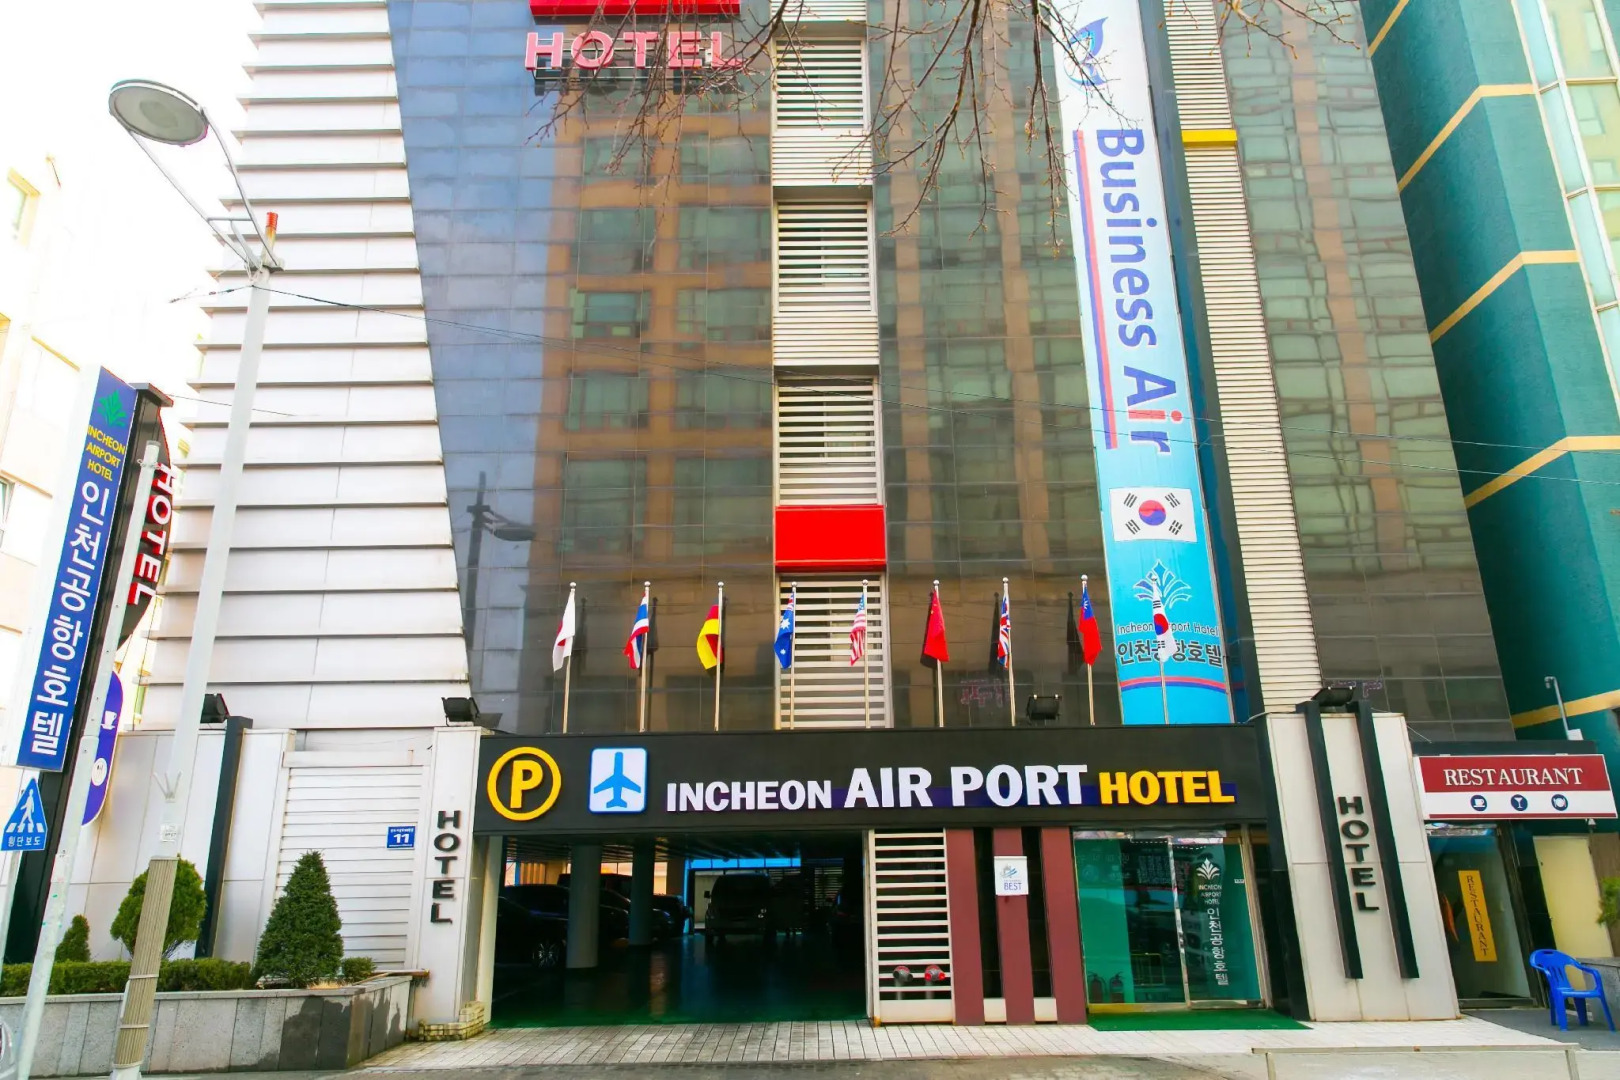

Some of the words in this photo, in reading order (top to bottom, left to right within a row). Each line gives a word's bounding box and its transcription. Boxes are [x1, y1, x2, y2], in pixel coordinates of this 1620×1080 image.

[525, 31, 745, 70] HOTEL
[1095, 129, 1158, 348] Business
[1123, 365, 1183, 455] Air
[86, 442, 121, 469] AIRPORT
[87, 425, 126, 455] INCHEON
[87, 459, 113, 481] HOTEL
[127, 462, 177, 606] HOTEL
[31, 481, 110, 756] 인천공항호텔
[1117, 622, 1154, 634] Incheon
[1194, 623, 1219, 636] Hotel
[1118, 640, 1222, 668] 인천항호텔
[667, 779, 832, 812] INCHEON
[844, 767, 933, 808] AIR
[950, 764, 1088, 807] PORT
[1099, 770, 1235, 804] HOTEL
[1443, 767, 1584, 787] RESTAURANT
[8, 835, 41, 847] 횡단보도
[393, 833, 410, 844] 11
[1338, 795, 1380, 913] HOTEL
[430, 810, 461, 924] HOTEL
[1004, 882, 1022, 891] BEST
[1466, 875, 1488, 956] RESTAURANT
[1207, 908, 1229, 985] 인천공항호텔
